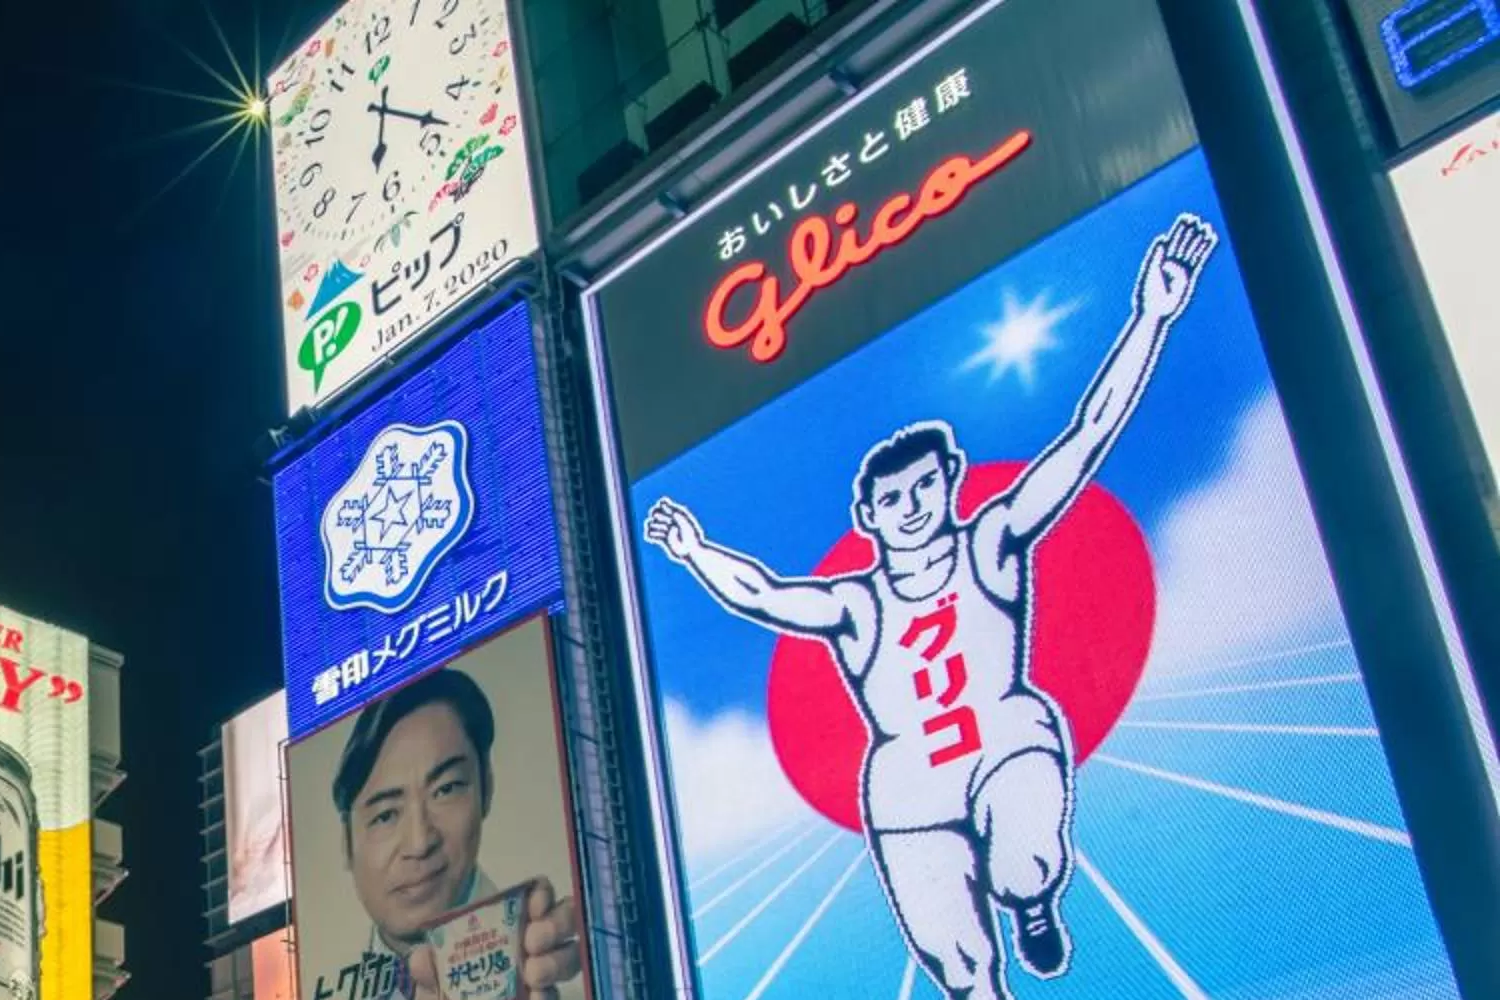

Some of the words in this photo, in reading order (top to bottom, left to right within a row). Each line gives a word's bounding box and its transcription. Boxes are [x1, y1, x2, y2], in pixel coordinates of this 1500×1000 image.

[365, 16, 392, 55] 12
[448, 23, 477, 55] 3
[329, 61, 356, 93] 11
[444, 75, 471, 101] 4
[303, 108, 331, 149] 10
[419, 130, 442, 157] 5
[298, 162, 323, 188] 9
[717, 67, 973, 260] おいしさと健康
[382, 170, 401, 202] 6
[312, 187, 337, 220] 8
[344, 191, 366, 224] 7
[371, 211, 465, 315] ピップ
[370, 309, 421, 353] Jan.
[446, 238, 510, 288] 2020
[311, 569, 508, 706] 雪印メグミルク
[898, 591, 983, 769] グリコ
